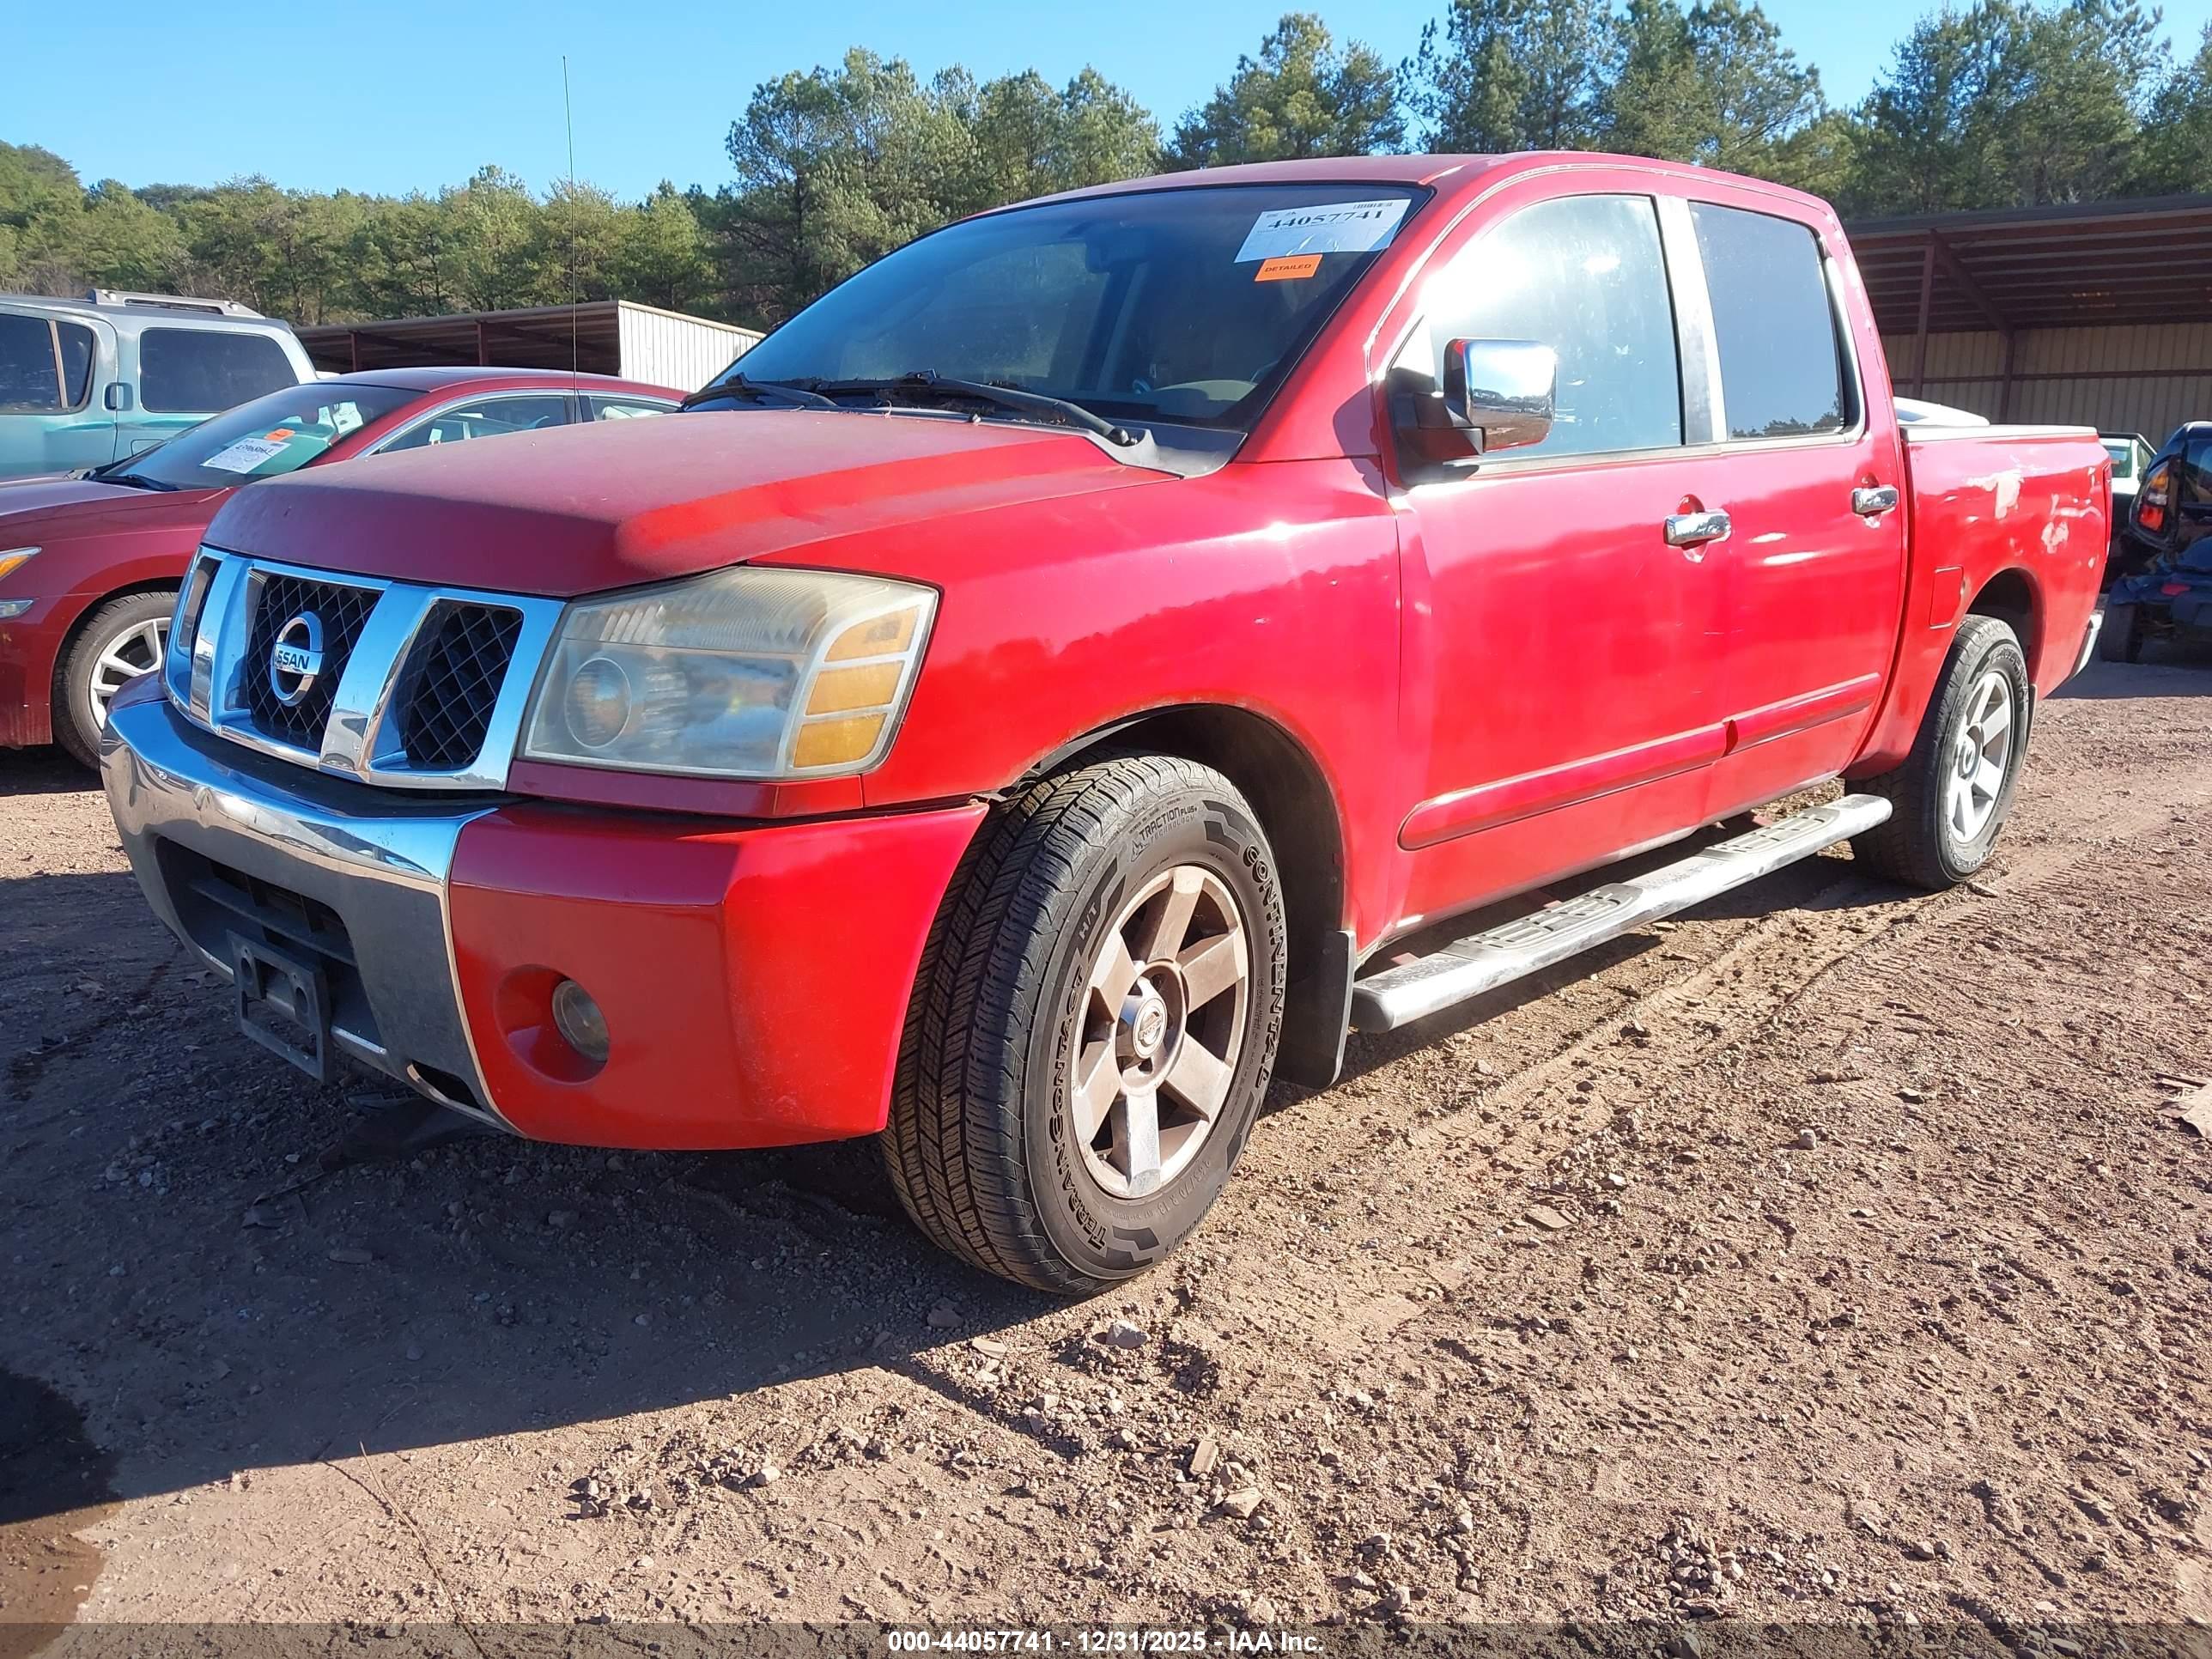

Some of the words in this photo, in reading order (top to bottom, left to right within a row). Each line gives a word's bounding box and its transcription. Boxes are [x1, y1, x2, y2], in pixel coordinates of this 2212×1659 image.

[1267, 210, 1382, 229] 44057741
[1264, 263, 1312, 273] DETAILED
[275, 650, 310, 670] SSAN
[1151, 815, 1195, 843] TECHNOLOGY
[1243, 843, 1286, 1090] CONTINENTAL
[1049, 963, 1107, 1250] TERRAINCONTACT
[1079, 902, 1098, 941] H/T
